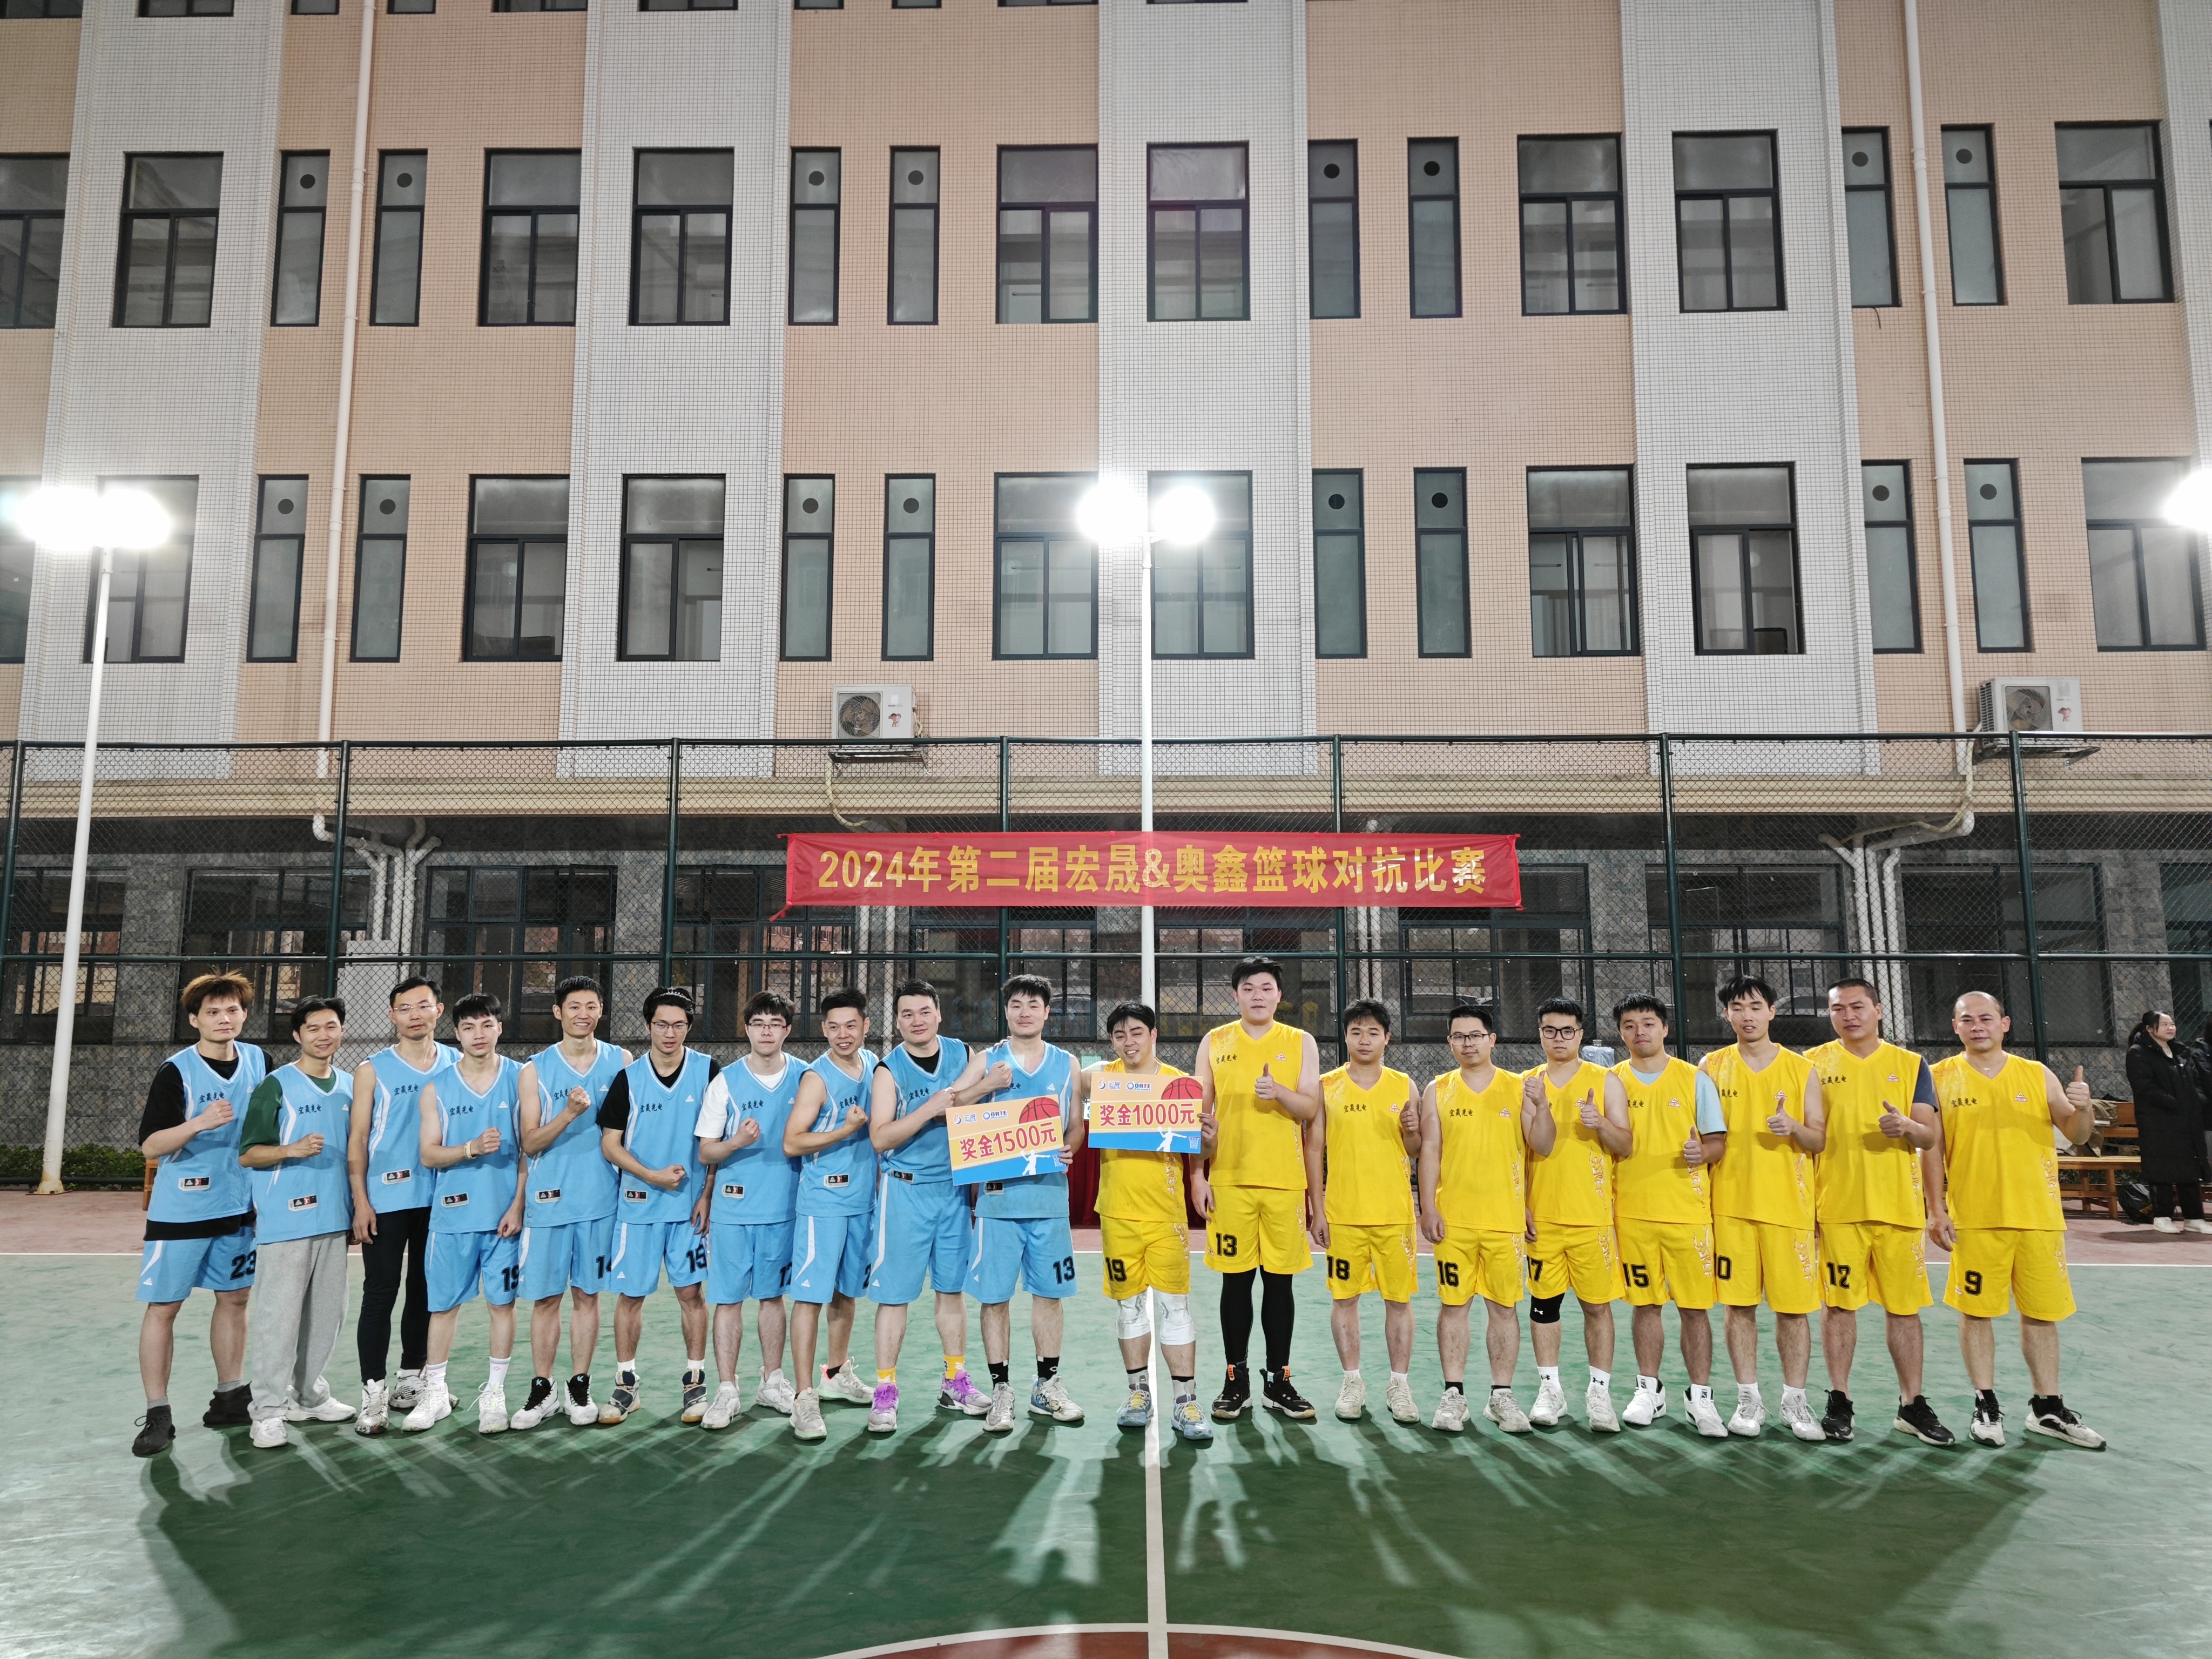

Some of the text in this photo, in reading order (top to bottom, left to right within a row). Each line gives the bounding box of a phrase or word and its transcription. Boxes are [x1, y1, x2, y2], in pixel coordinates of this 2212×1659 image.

[818, 845, 1486, 894] 2024年第二届宏晟&奥鑫篮球对抗比赛
[1100, 1103, 1195, 1127] 奖金1000元
[960, 1122, 1057, 1162] 奖金1500元
[686, 1243, 707, 1274] 15
[1216, 1232, 1237, 1257] 13
[231, 1249, 257, 1281] 23
[1053, 1257, 1075, 1285] 13
[1105, 1257, 1128, 1283] 19
[1327, 1255, 1350, 1286] 18
[1437, 1259, 1459, 1288] 16
[1622, 1262, 1650, 1289] 15
[1826, 1261, 1851, 1291] 12
[1964, 1270, 1983, 1297] 9
